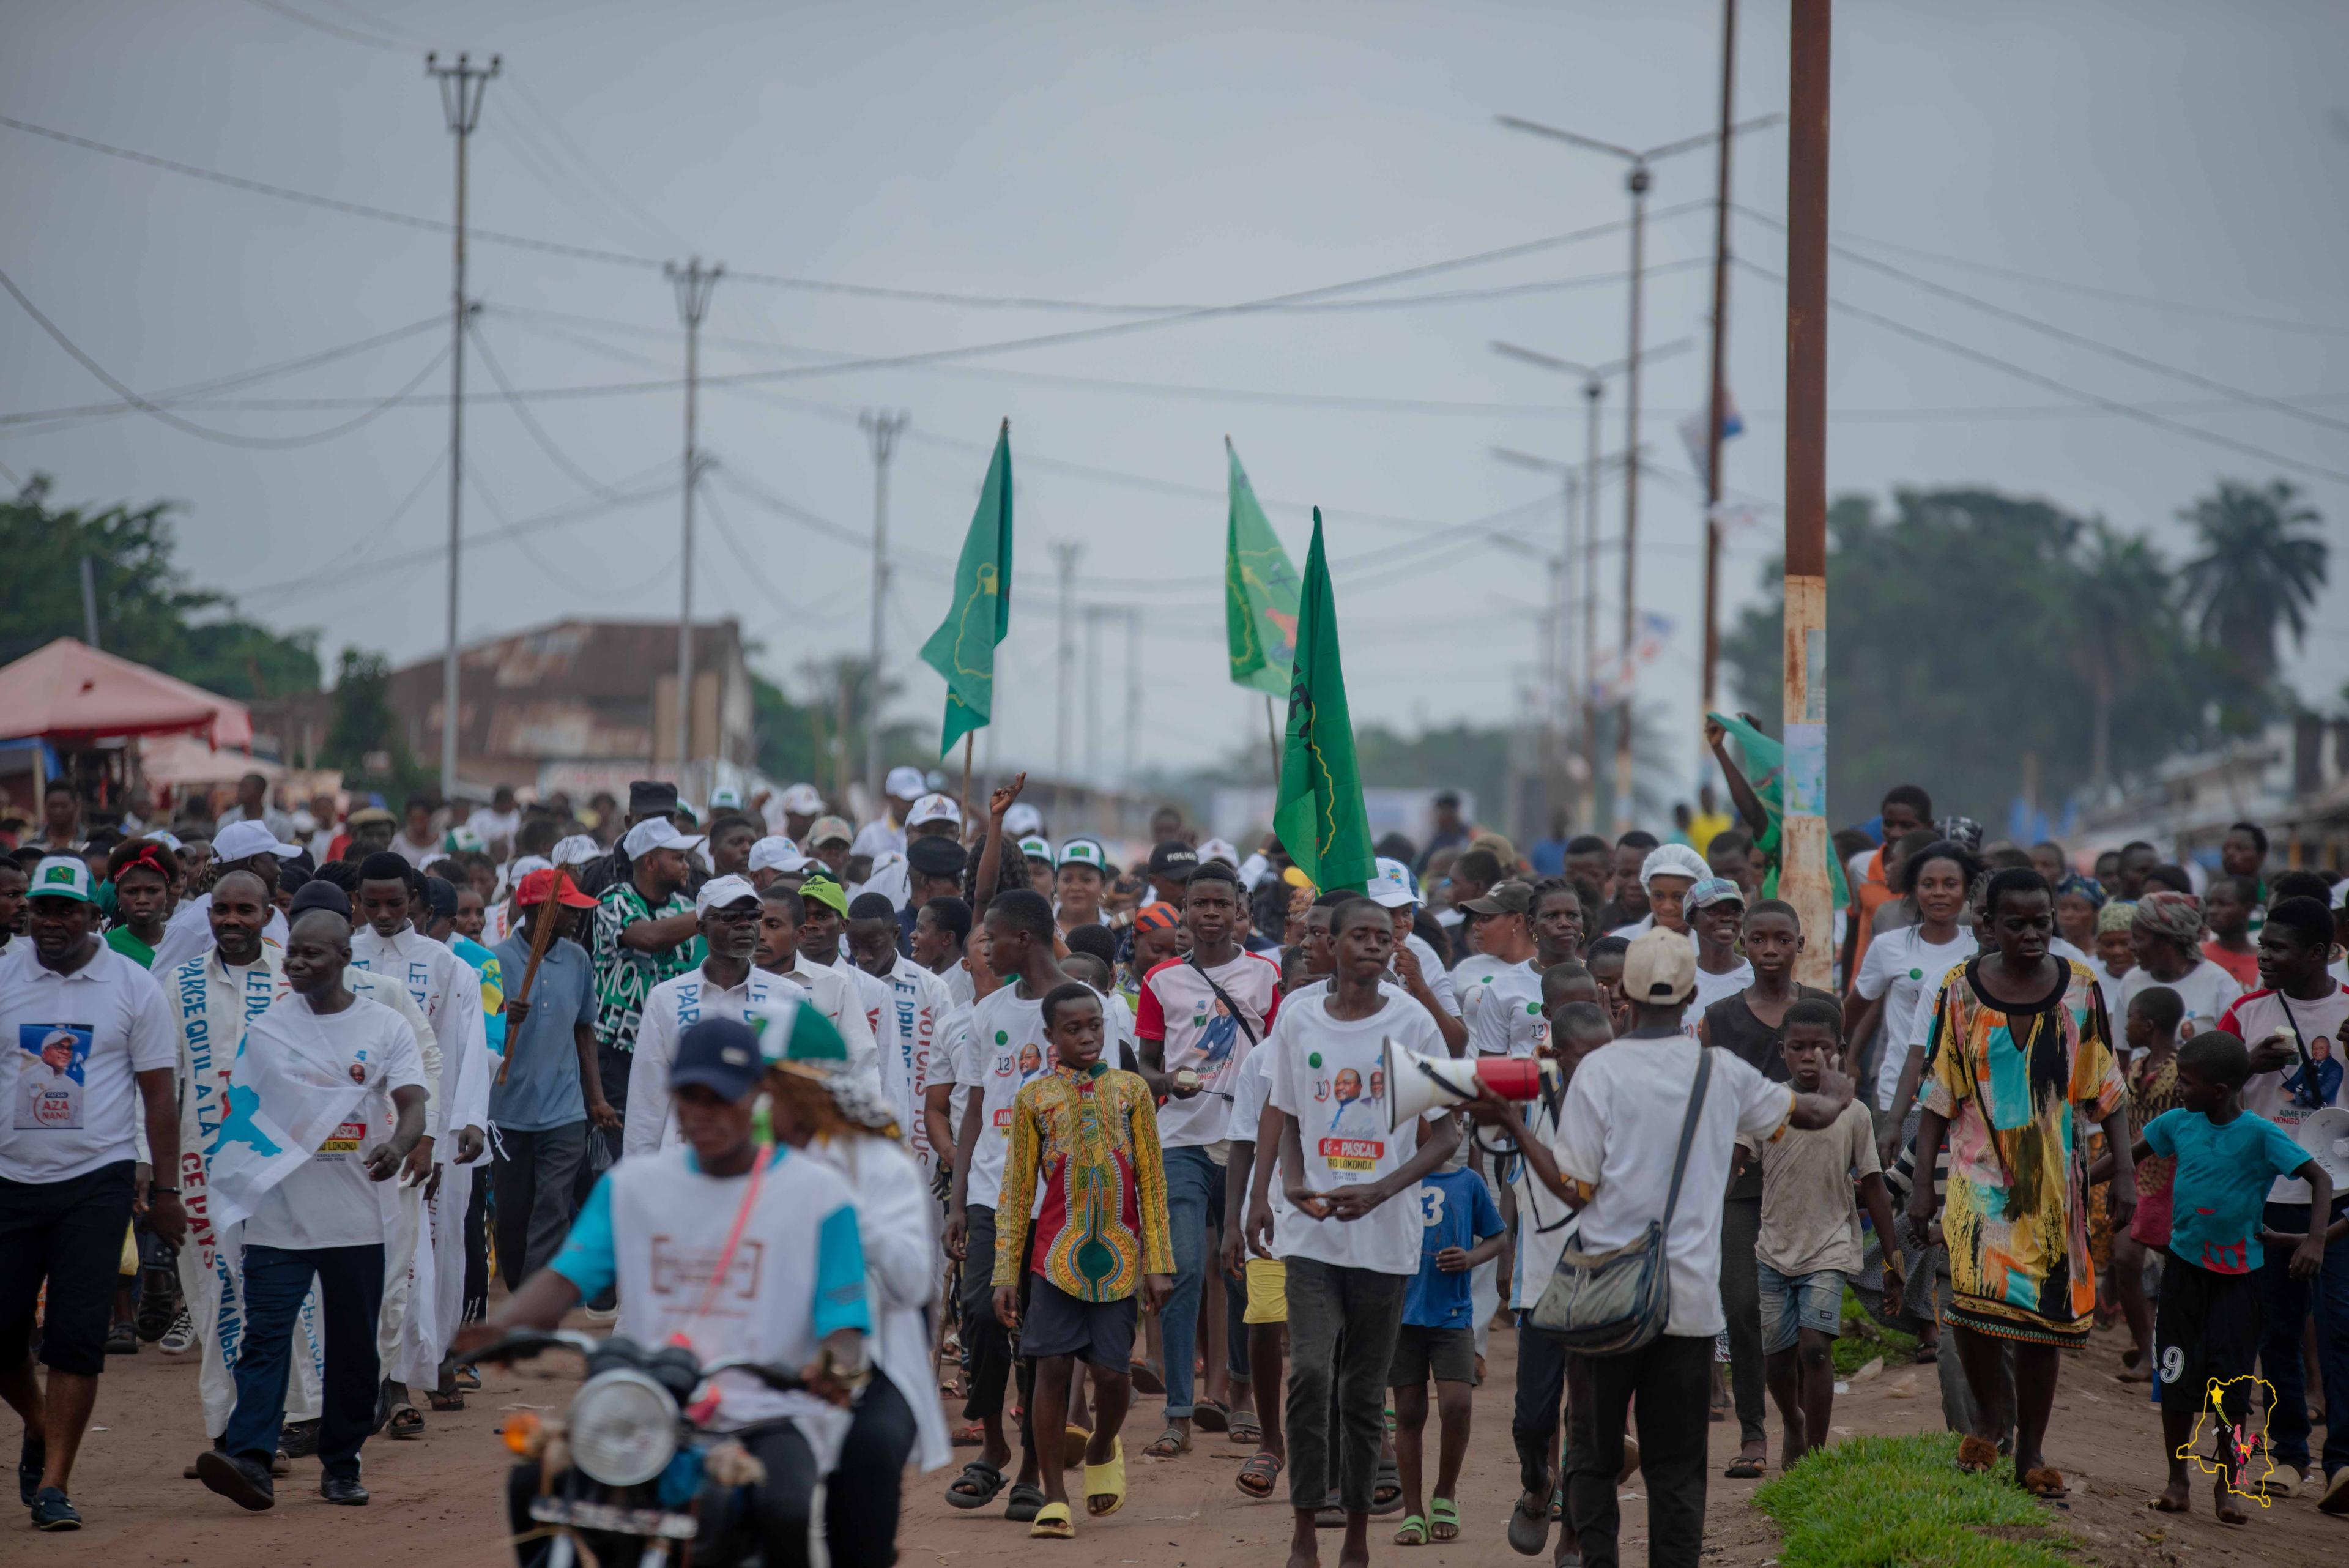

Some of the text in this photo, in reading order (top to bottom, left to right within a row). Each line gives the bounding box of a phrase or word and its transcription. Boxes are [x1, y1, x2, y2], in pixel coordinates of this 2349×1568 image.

[1167, 852, 1197, 862] POLICE
[409, 962, 427, 985] LE
[178, 957, 206, 1019] PARCE
[246, 970, 272, 992] LE
[1532, 1024, 1544, 1036] 12
[185, 1020, 212, 1079] QU'IL
[998, 1057, 1010, 1071] 12
[1196, 1065, 1215, 1074] AIME
[1198, 1071, 1217, 1081] ONGO
[195, 1085, 212, 1101] A
[1316, 1081, 1326, 1096] 12
[43, 1101, 69, 1111] AZA
[42, 1111, 70, 1120] NANU
[2273, 1115, 2300, 1125] MONGO
[2279, 1109, 2299, 1118] AIME
[197, 1105, 220, 1137] LA
[331, 1125, 361, 1139] ASCAL
[328, 1142, 358, 1151] LOKONDA
[1341, 1142, 1378, 1158] PASCAL
[181, 1152, 206, 1190] CE
[1340, 1159, 1373, 1170] LOKONDA
[1420, 1186, 1446, 1227] 3
[185, 1194, 217, 1270] PAYS
[2160, 1346, 2184, 1383] 9
